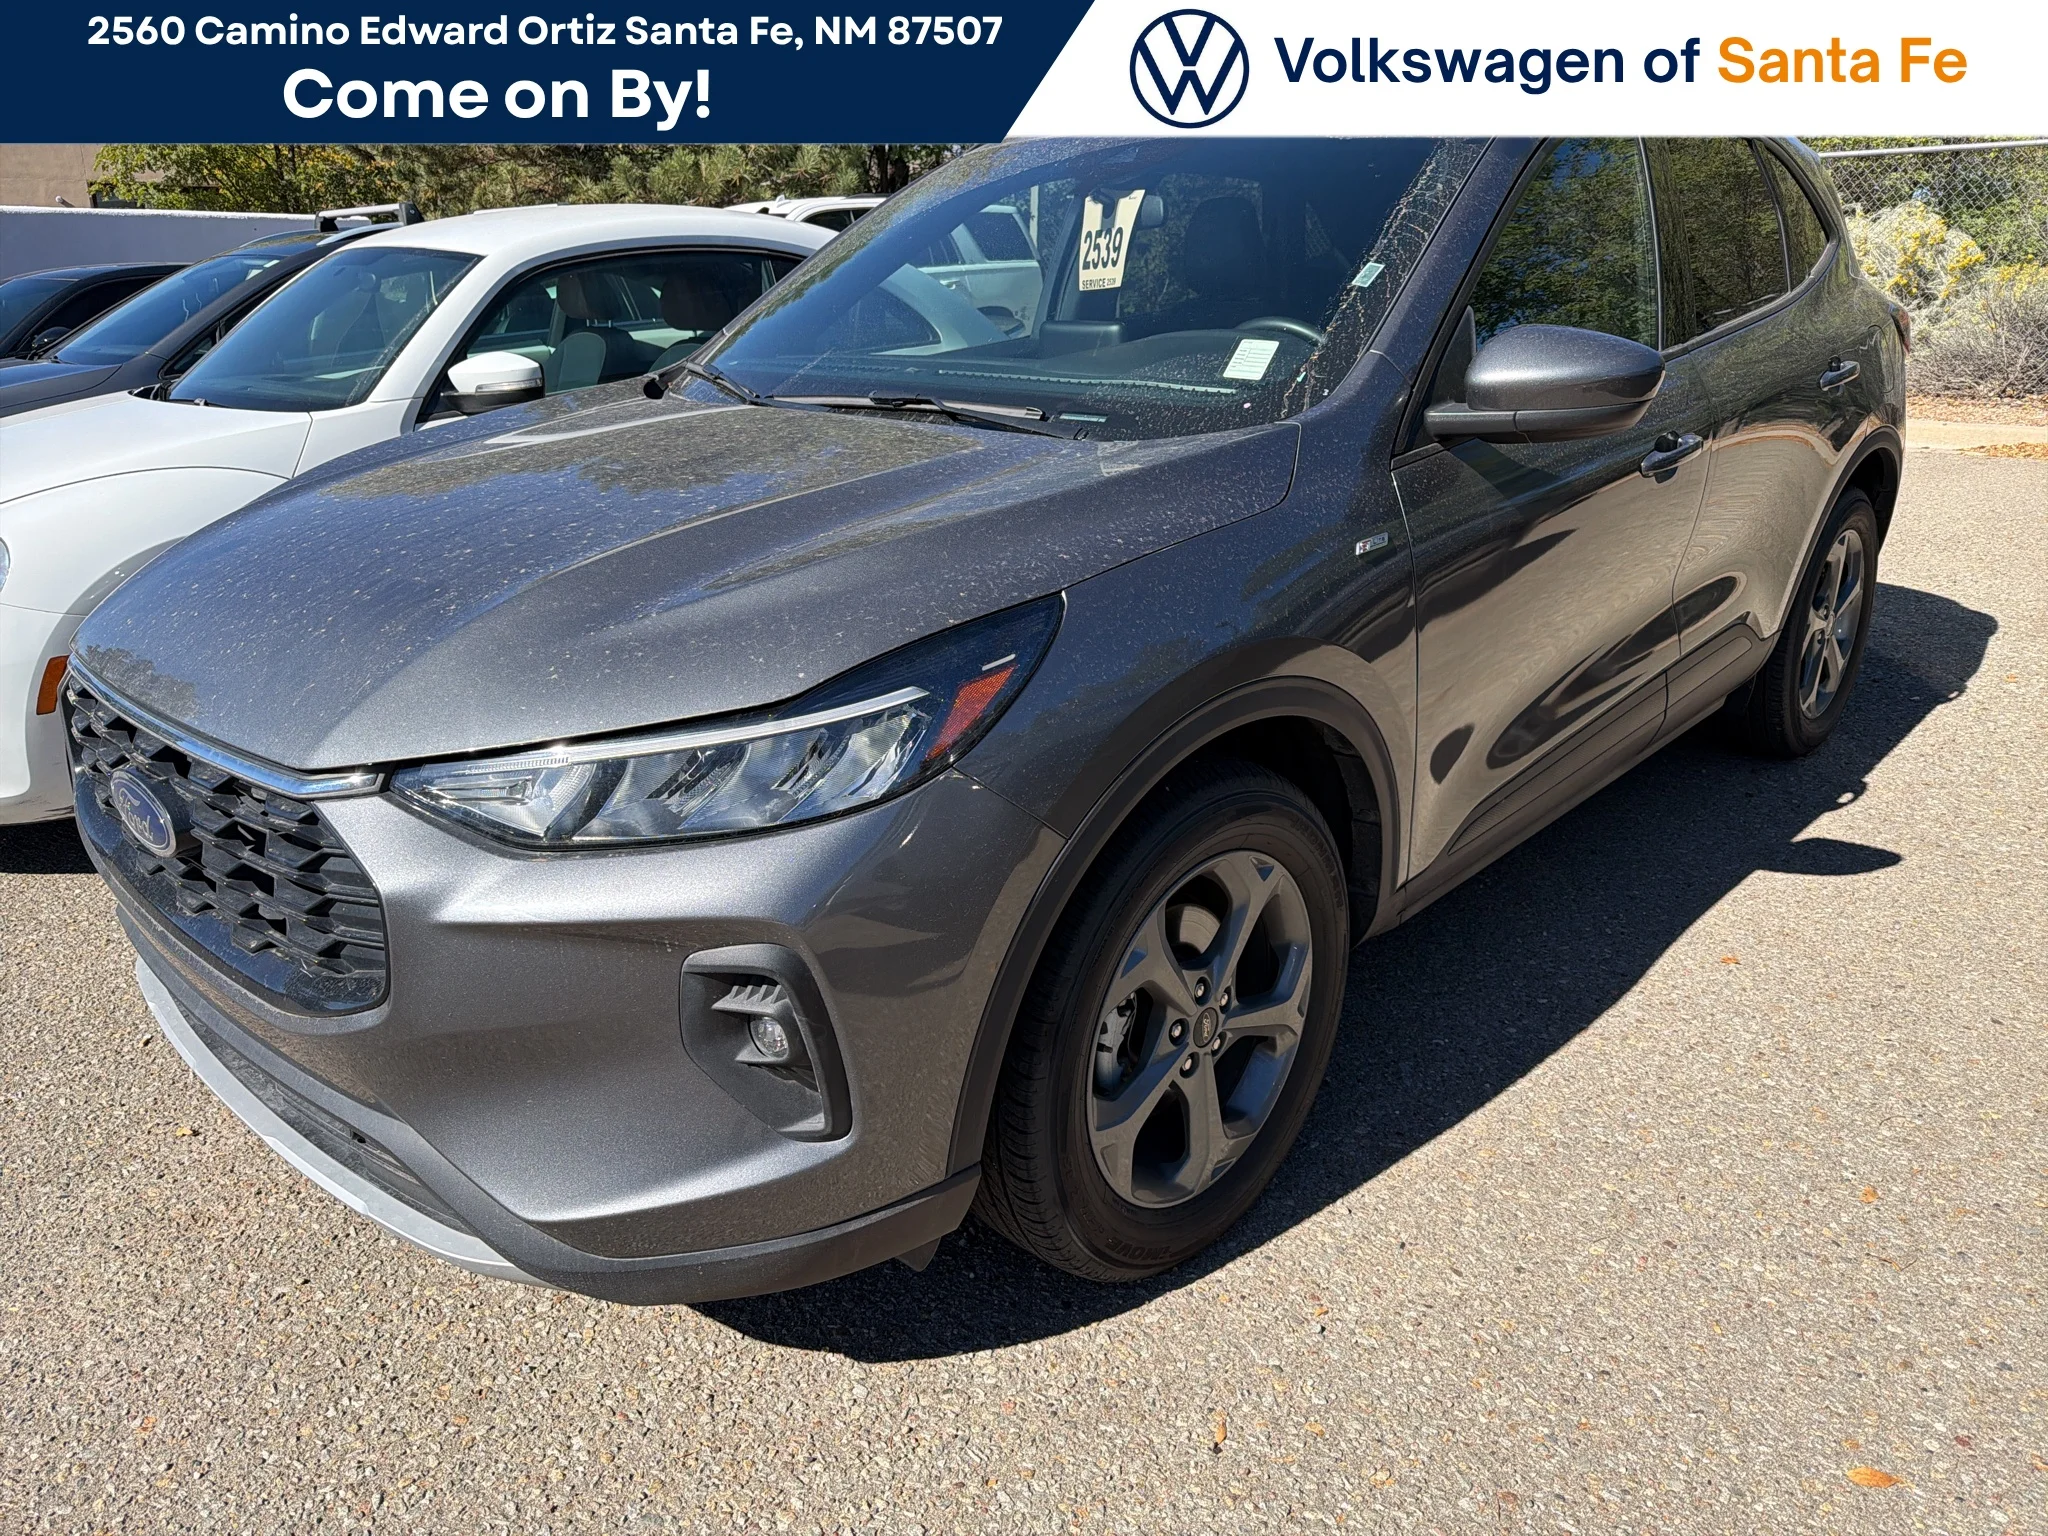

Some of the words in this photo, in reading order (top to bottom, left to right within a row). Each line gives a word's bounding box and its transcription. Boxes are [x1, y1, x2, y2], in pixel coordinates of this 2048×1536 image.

[1082, 227, 1123, 270] 2539
[1082, 278, 1106, 289] SERVICE
[119, 787, 154, 841] Ford
